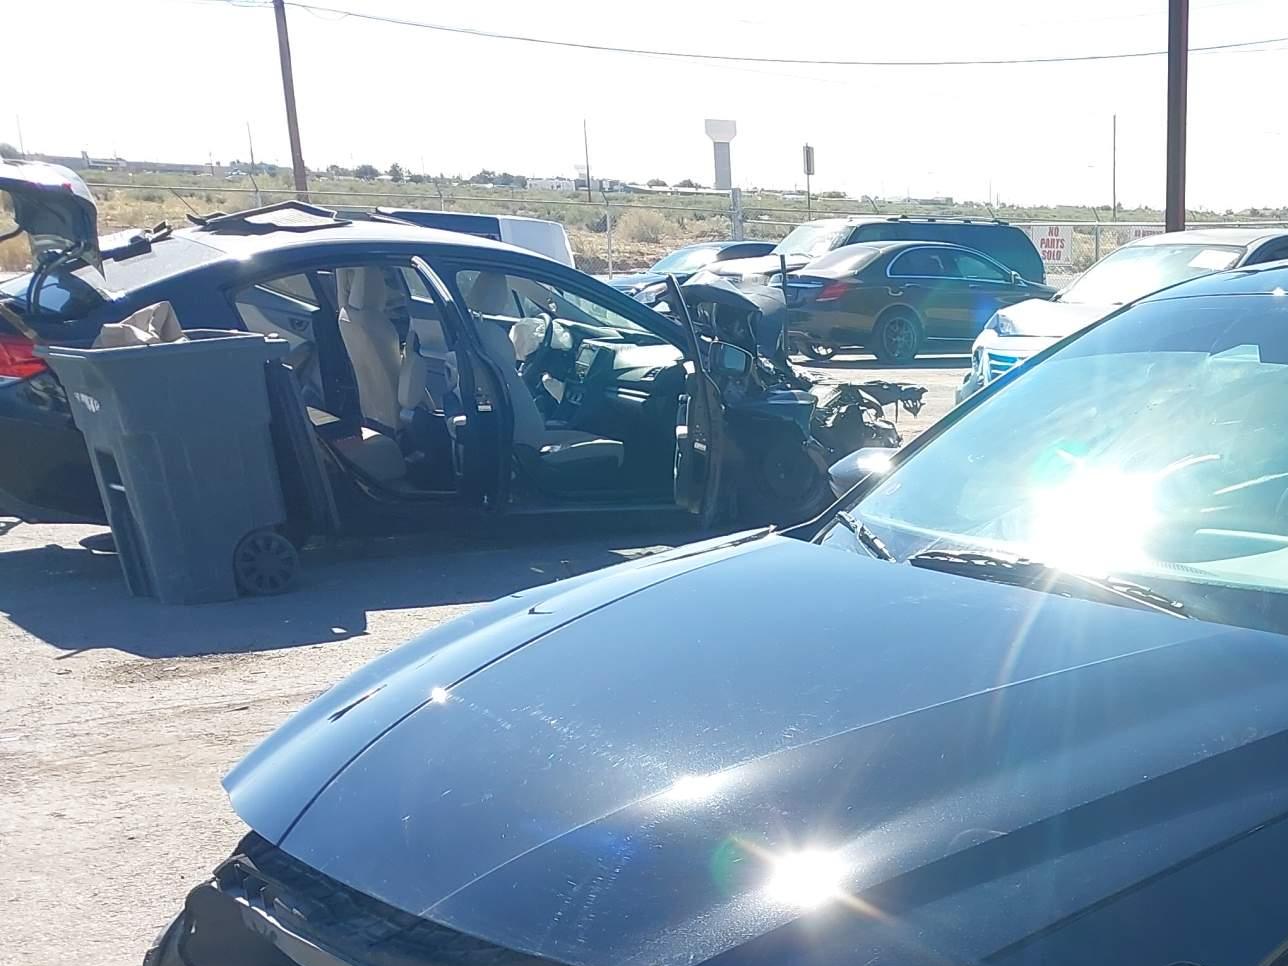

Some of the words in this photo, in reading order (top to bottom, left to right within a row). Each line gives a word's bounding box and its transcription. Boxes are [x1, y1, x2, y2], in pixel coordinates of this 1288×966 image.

[1048, 226, 1059, 237] NO
[1040, 238, 1065, 249] PARTS
[1041, 250, 1062, 261] SOLD
